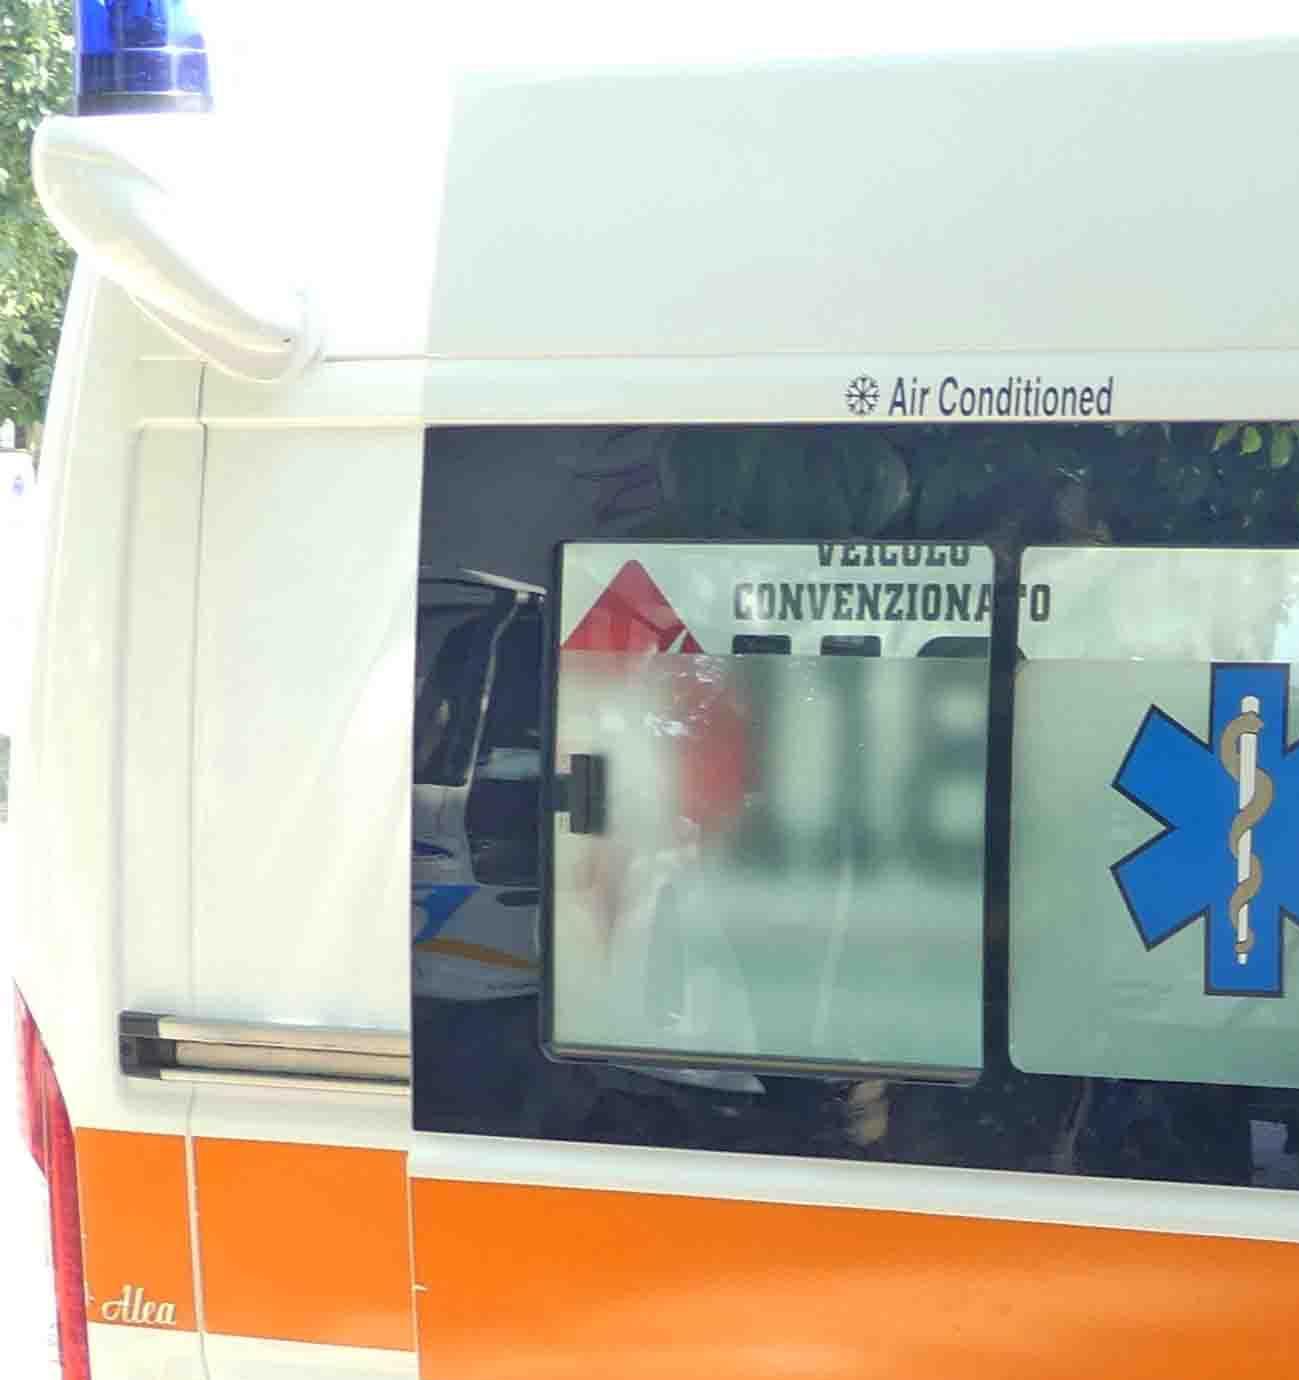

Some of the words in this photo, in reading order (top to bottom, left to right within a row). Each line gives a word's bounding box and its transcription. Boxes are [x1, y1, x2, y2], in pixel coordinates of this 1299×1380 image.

[887, 375, 931, 417] Air
[938, 375, 1114, 417] Conditioned
[734, 583, 1051, 622] CONVENZIONAO
[101, 1284, 177, 1326] Alea
